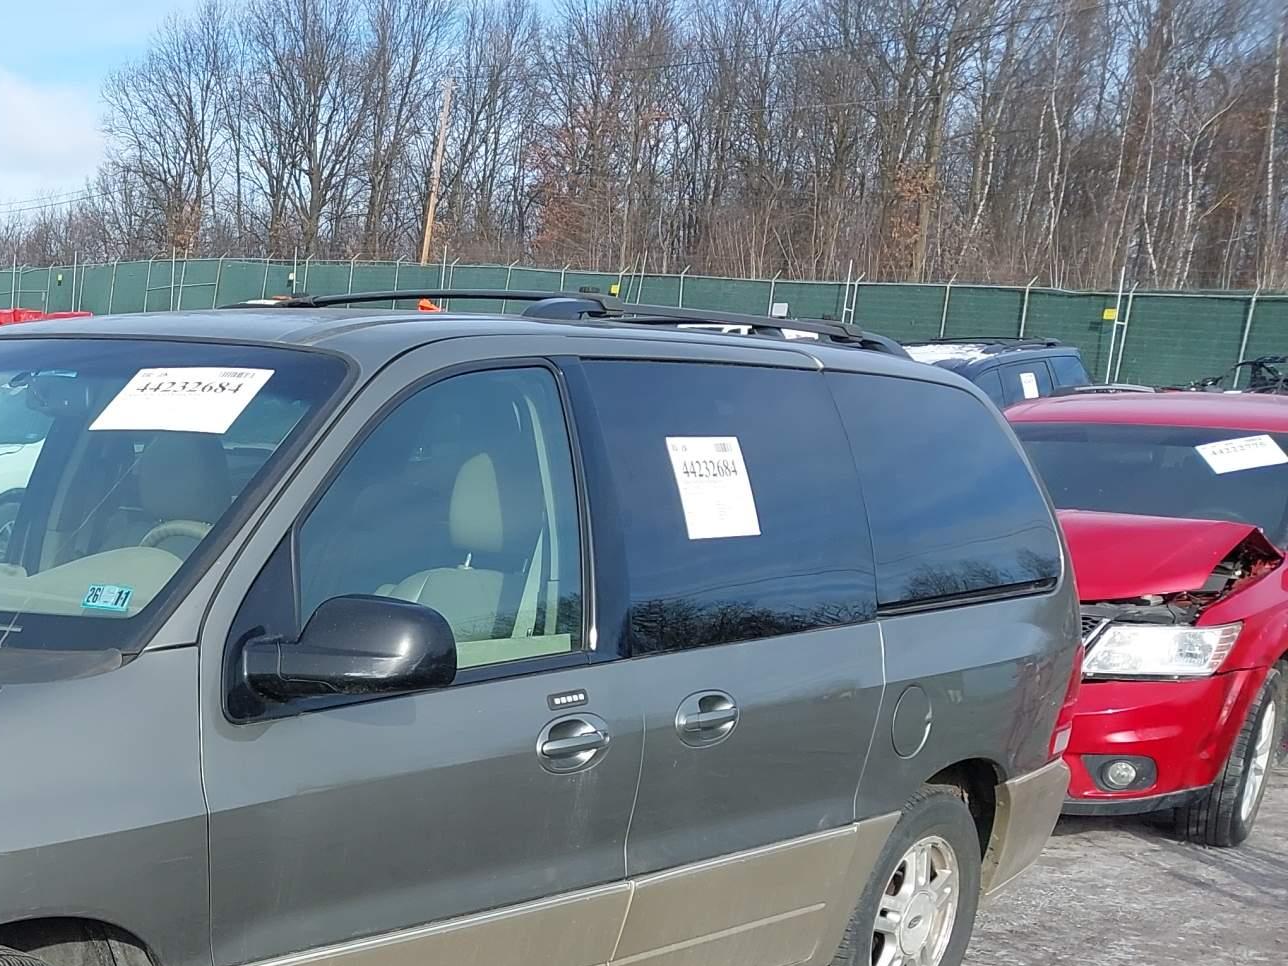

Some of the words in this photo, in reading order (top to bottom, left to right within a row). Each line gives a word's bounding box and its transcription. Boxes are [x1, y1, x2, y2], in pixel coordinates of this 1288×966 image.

[136, 381, 244, 394] 44232684
[682, 459, 738, 478] 44232684
[86, 586, 102, 603] 26
